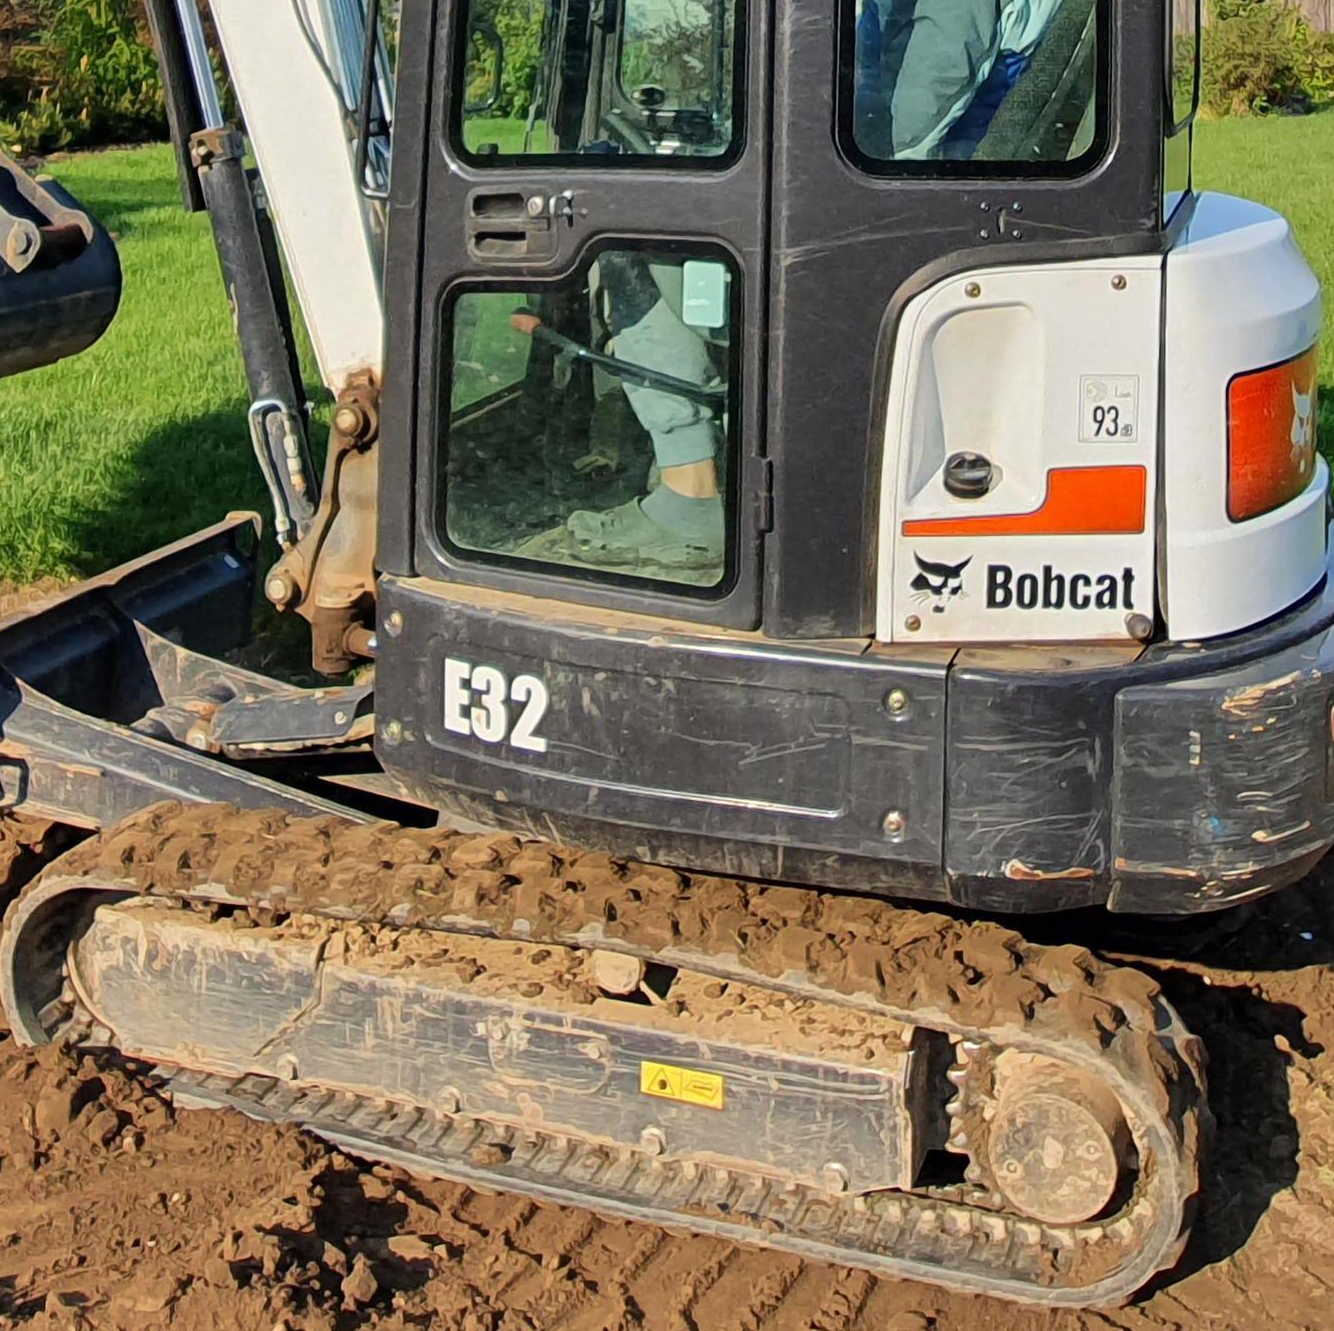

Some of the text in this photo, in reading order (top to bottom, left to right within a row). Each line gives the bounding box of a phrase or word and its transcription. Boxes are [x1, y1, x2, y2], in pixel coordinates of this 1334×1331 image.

[1093, 405, 1119, 437] 93
[986, 564, 1135, 610] Bobcat
[444, 658, 547, 752] E32
